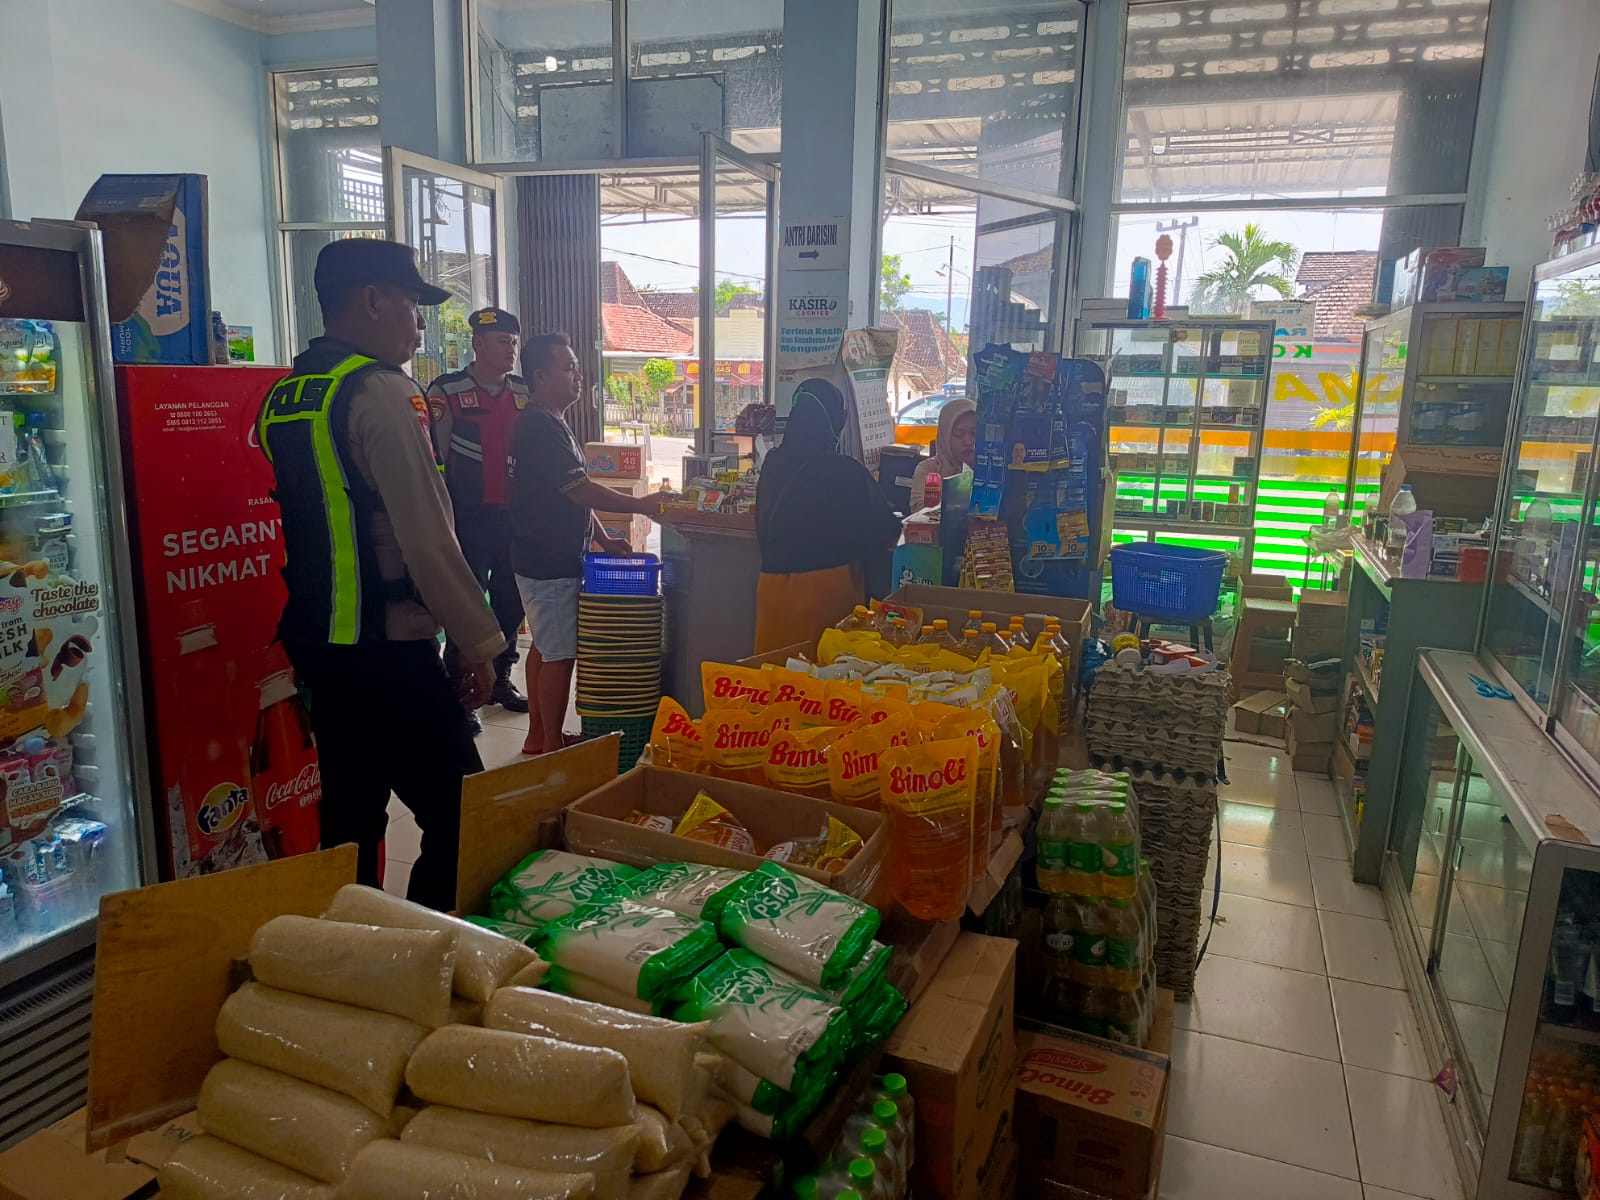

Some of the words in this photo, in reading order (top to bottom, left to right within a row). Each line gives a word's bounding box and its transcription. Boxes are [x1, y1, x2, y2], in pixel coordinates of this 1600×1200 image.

[784, 225, 805, 247] ANTRI
[806, 224, 838, 246] DARISINI
[789, 299, 827, 310] KASIR
[155, 403, 187, 411] LAYANAN
[166, 554, 271, 594] NIKMAT
[31, 586, 71, 602] Taste
[75, 580, 97, 595] the
[32, 597, 97, 619] chocolate
[889, 757, 968, 795] Bimoli
[12, 786, 35, 797] CARA
[753, 879, 797, 920] PSM
